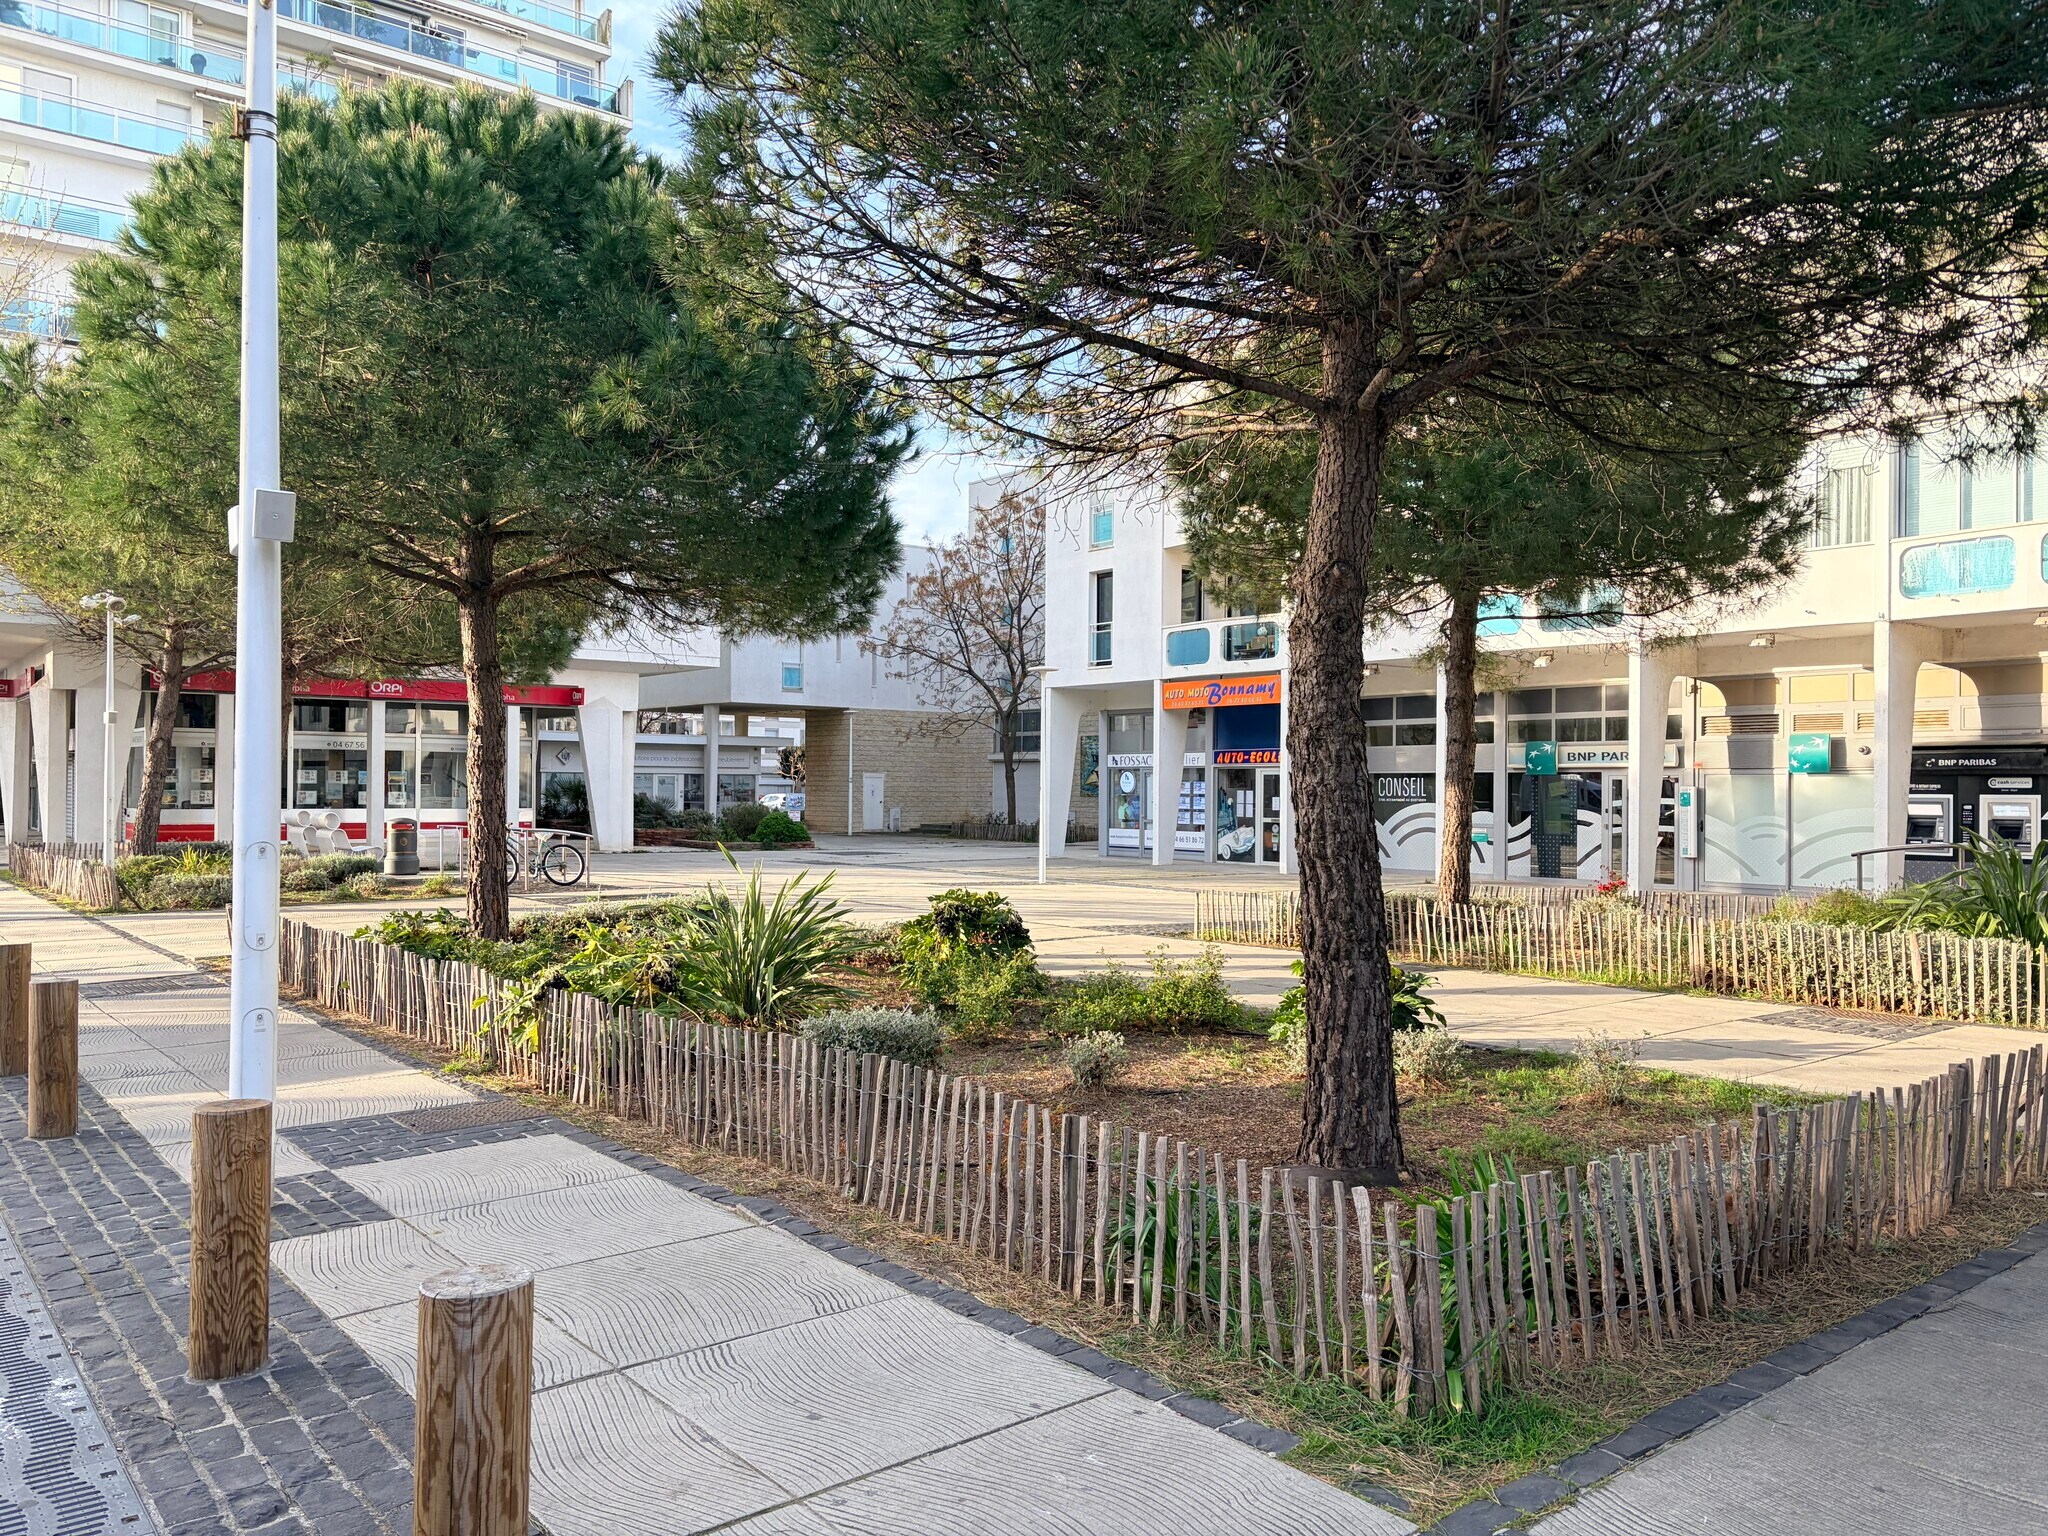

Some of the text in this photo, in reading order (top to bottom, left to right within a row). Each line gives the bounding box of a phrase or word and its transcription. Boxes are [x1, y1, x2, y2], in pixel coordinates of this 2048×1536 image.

[371, 681, 403, 693] ORPI
[1166, 681, 1276, 705] AUTO MOTO Bonnamy
[355, 741, 365, 749] 56
[1185, 753, 1200, 765] lier
[1567, 752, 1629, 761] BNP PAR
[1378, 777, 1427, 797] CONSEIL
